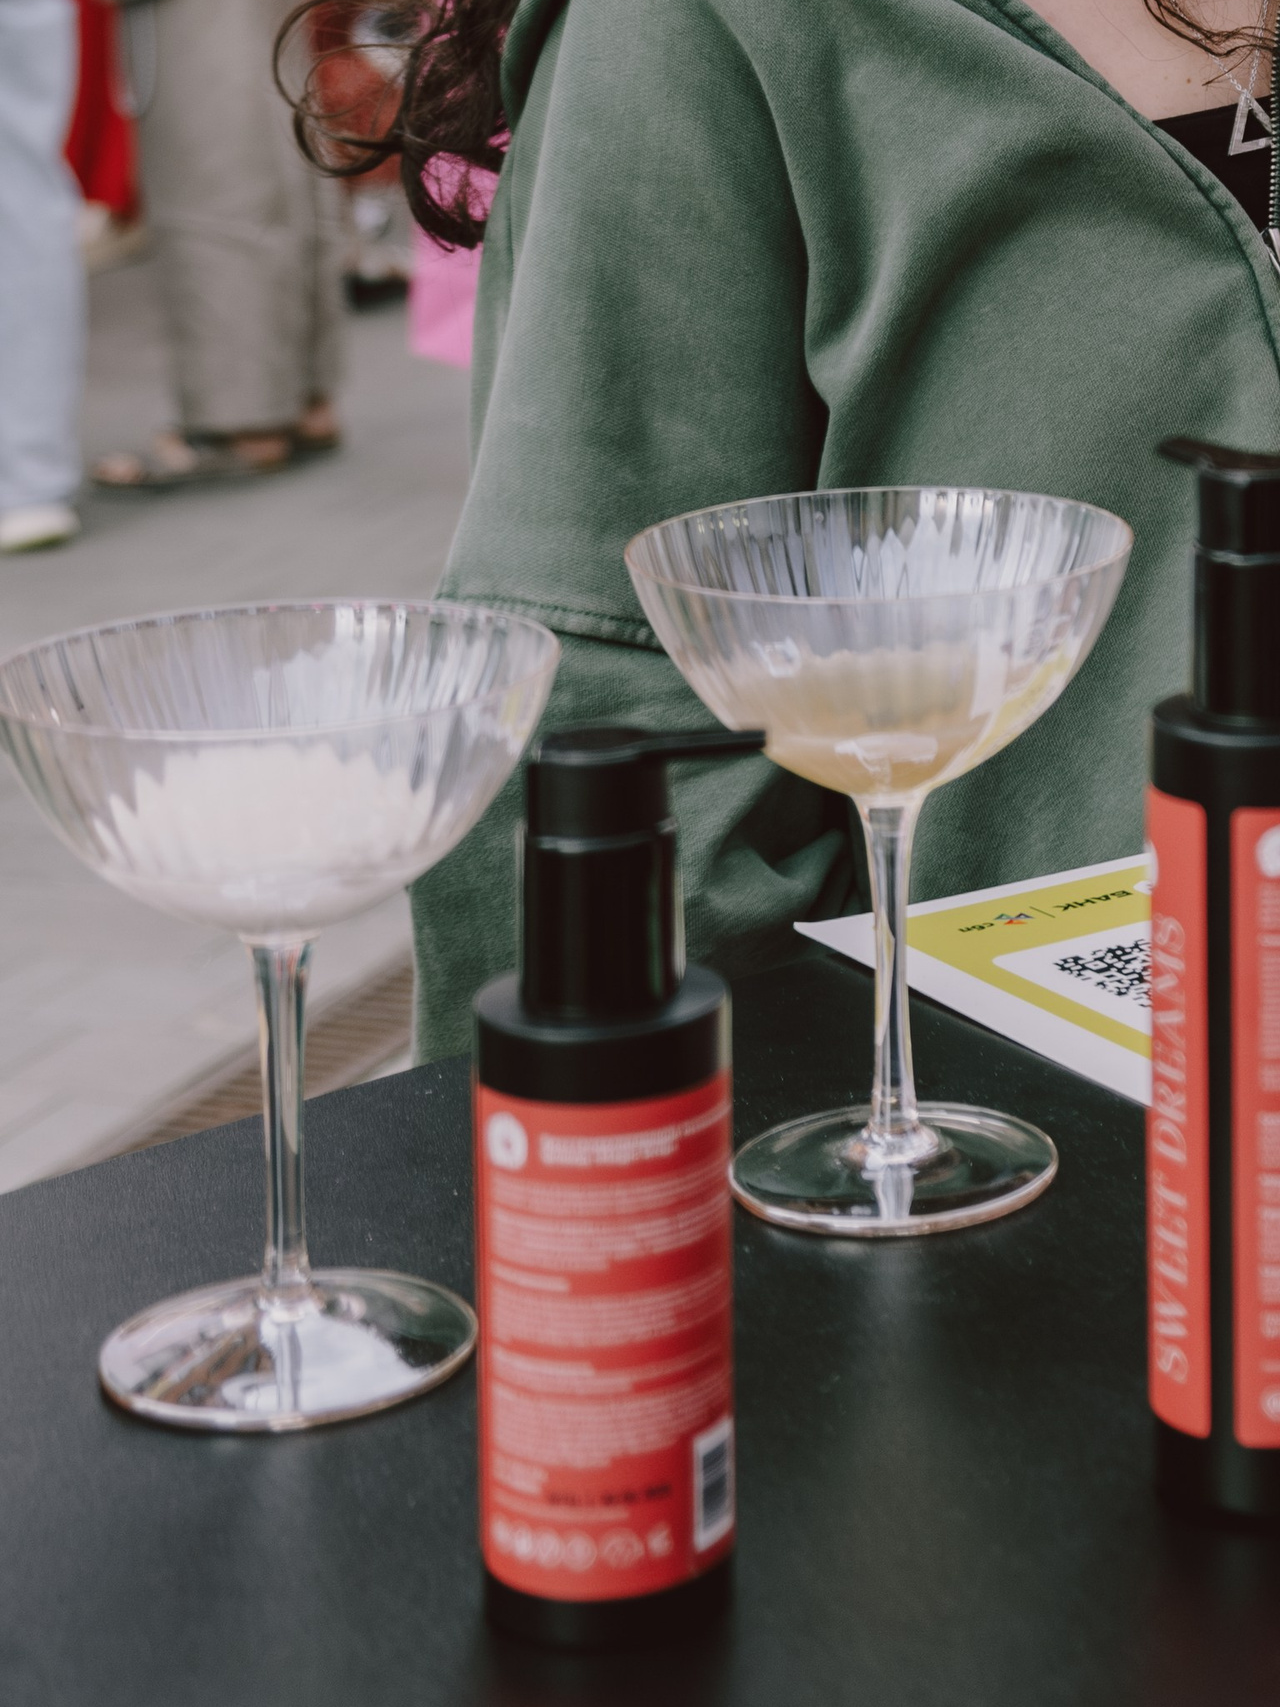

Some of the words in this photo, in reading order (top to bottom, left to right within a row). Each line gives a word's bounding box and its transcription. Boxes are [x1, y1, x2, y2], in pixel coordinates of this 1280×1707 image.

[1054, 890, 1134, 912] БАНК
[1151, 912, 1190, 1167] DREAMS
[1151, 1171, 1190, 1384] SWEET
